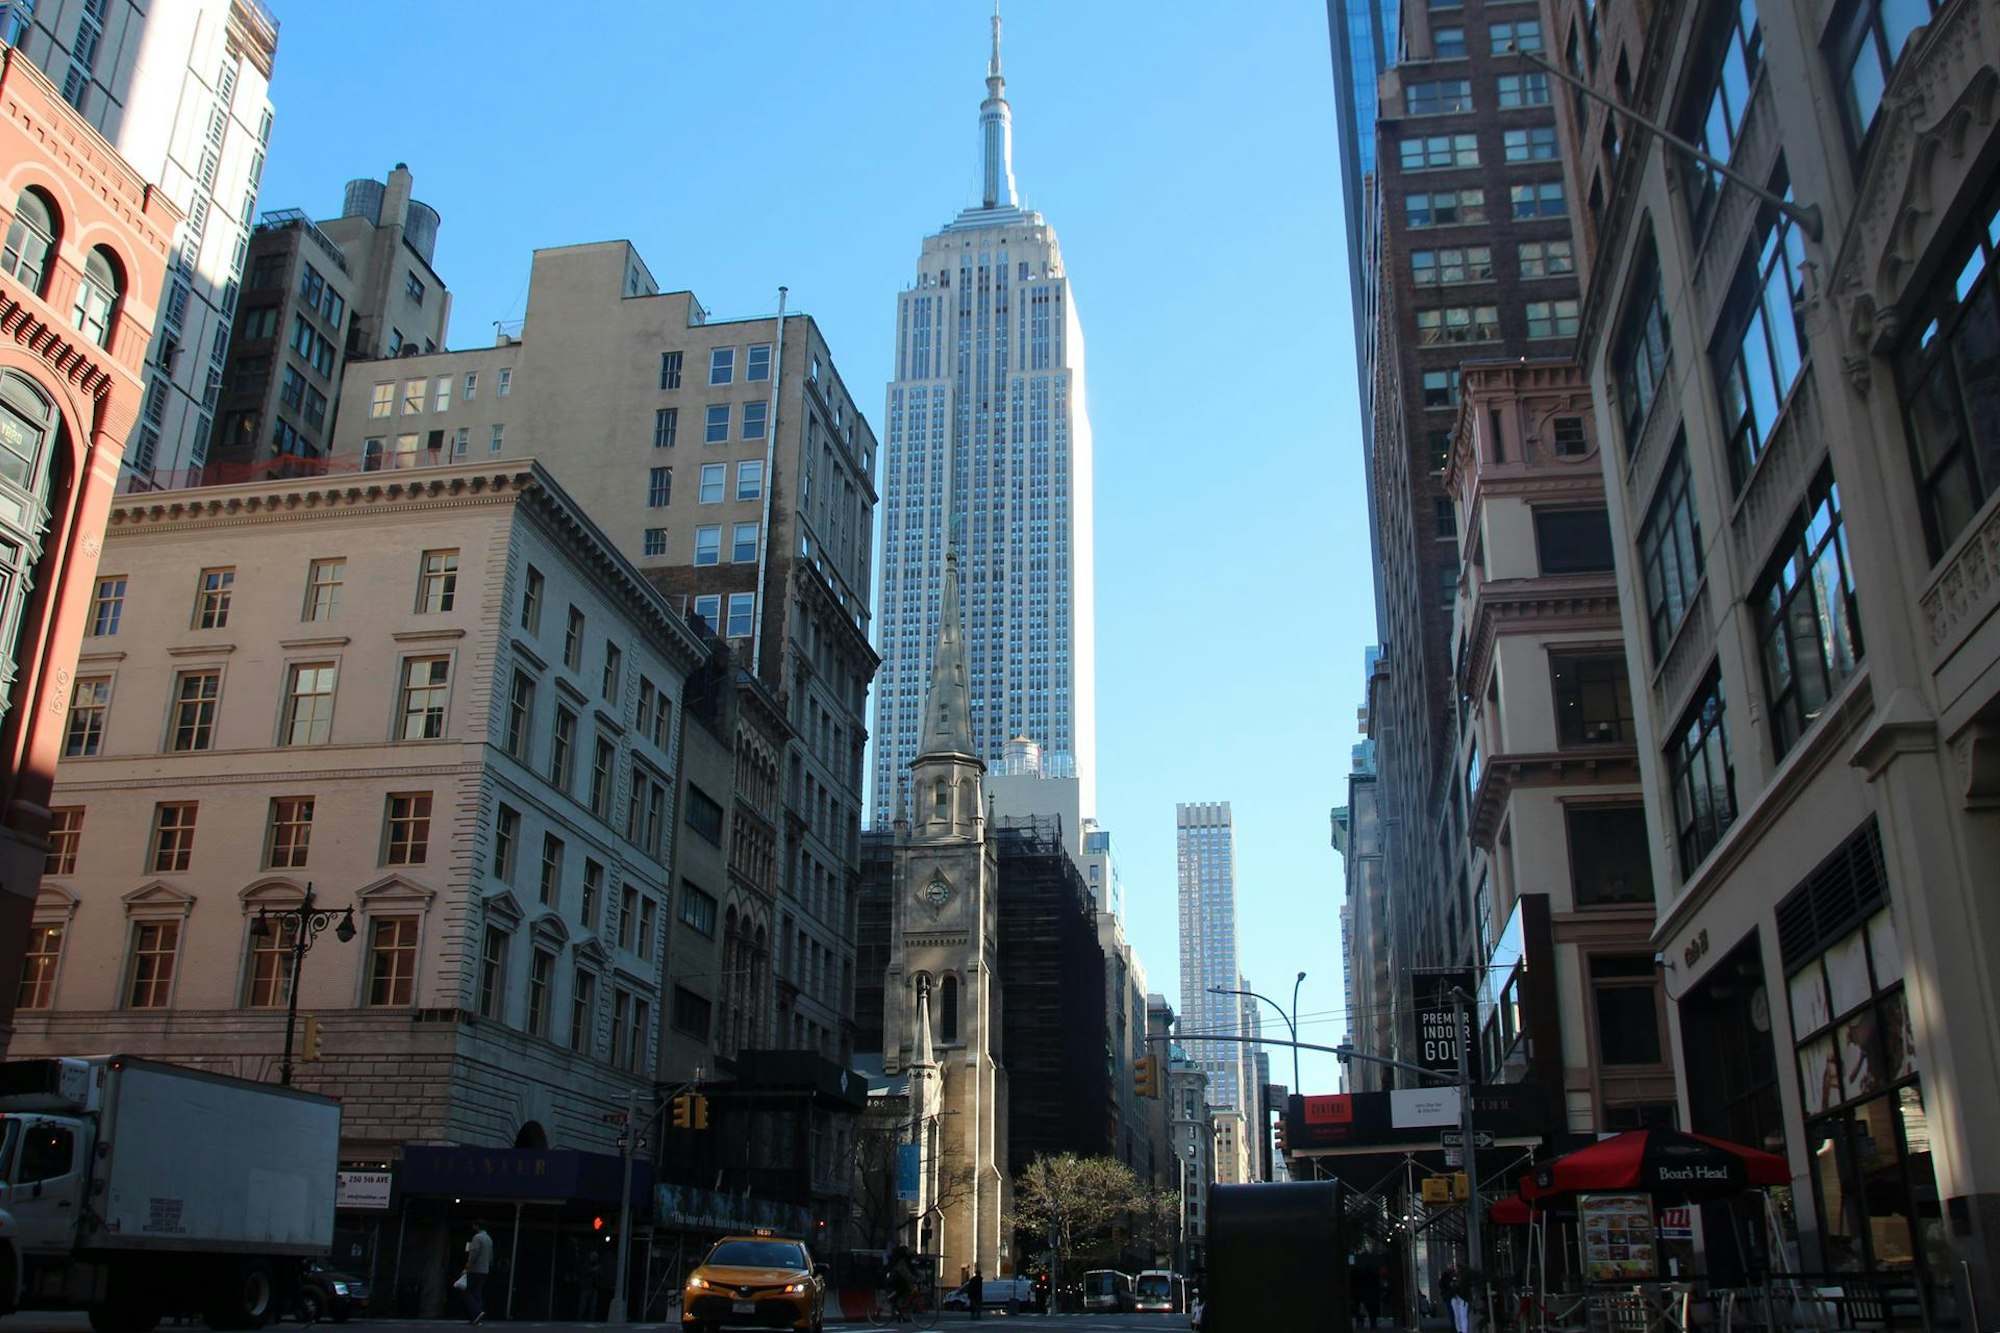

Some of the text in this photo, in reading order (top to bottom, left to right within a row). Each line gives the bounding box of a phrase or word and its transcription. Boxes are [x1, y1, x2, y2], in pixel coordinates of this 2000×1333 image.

[1422, 1012, 1470, 1025] PREMIR
[1423, 1025, 1471, 1039] INDOR
[349, 1175, 389, 1184] 250 5th AVE
[1658, 1166, 1728, 1180] Boar's Head
